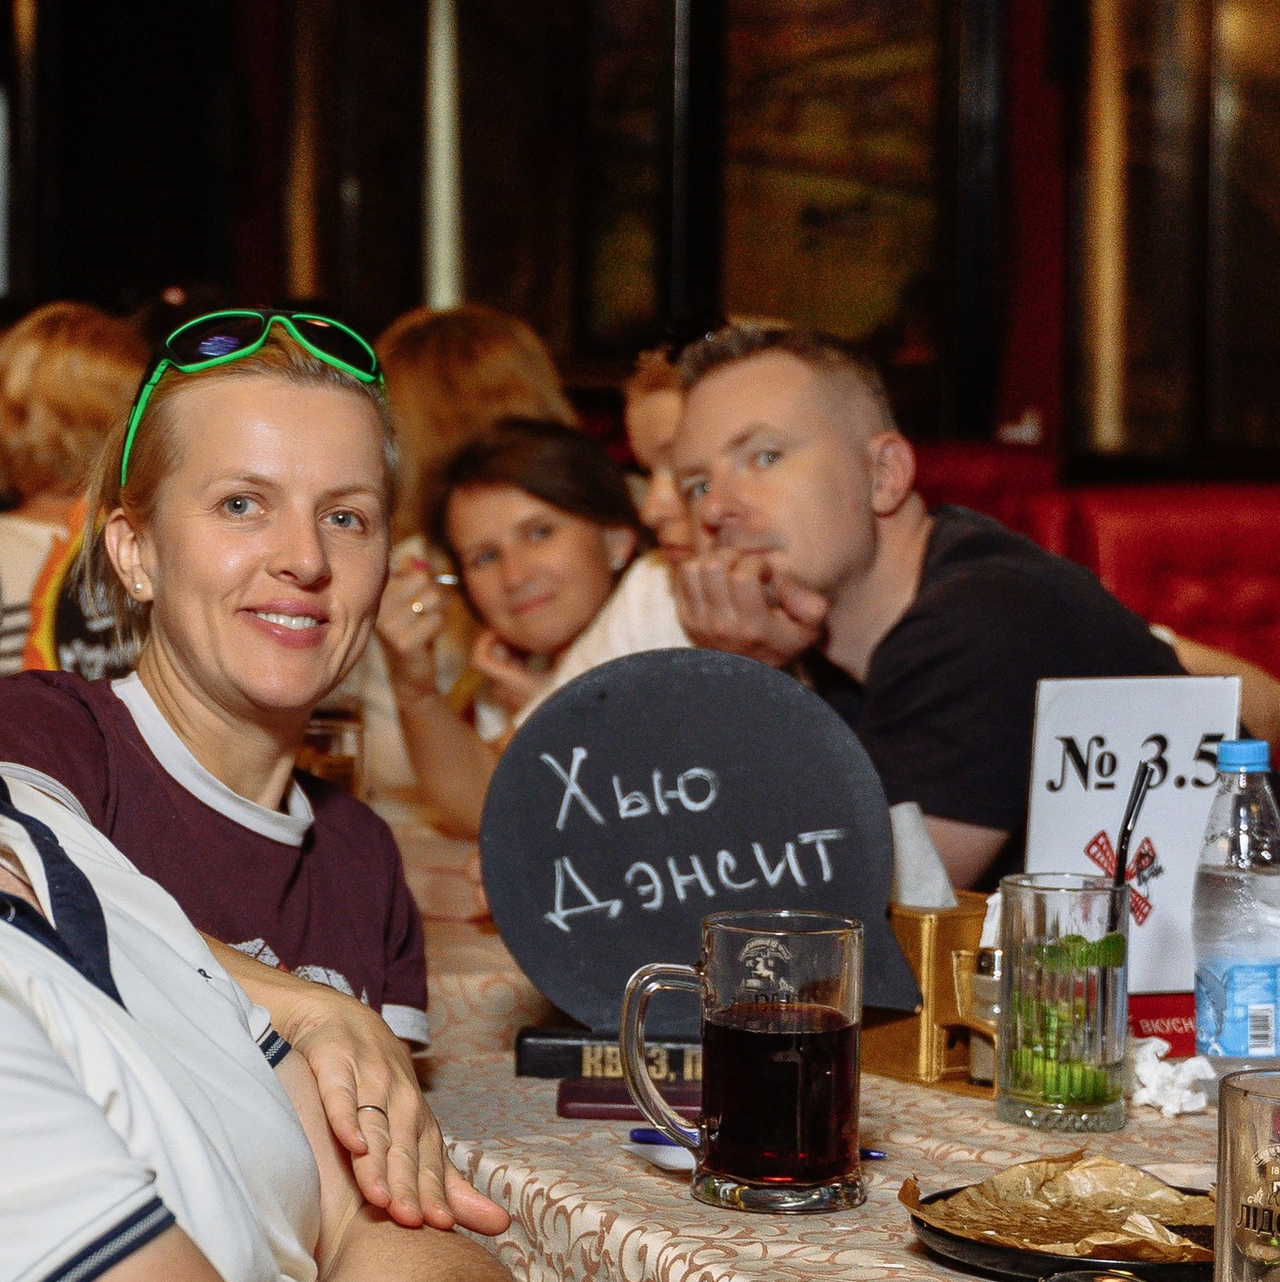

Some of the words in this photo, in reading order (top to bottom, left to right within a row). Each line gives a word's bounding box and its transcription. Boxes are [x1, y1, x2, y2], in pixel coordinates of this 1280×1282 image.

[1046, 734, 1117, 792] №
[1140, 732, 1224, 789] 3.5
[581, 1044, 677, 1082] КВЗ,
[1236, 1203, 1280, 1237] ЛІД
